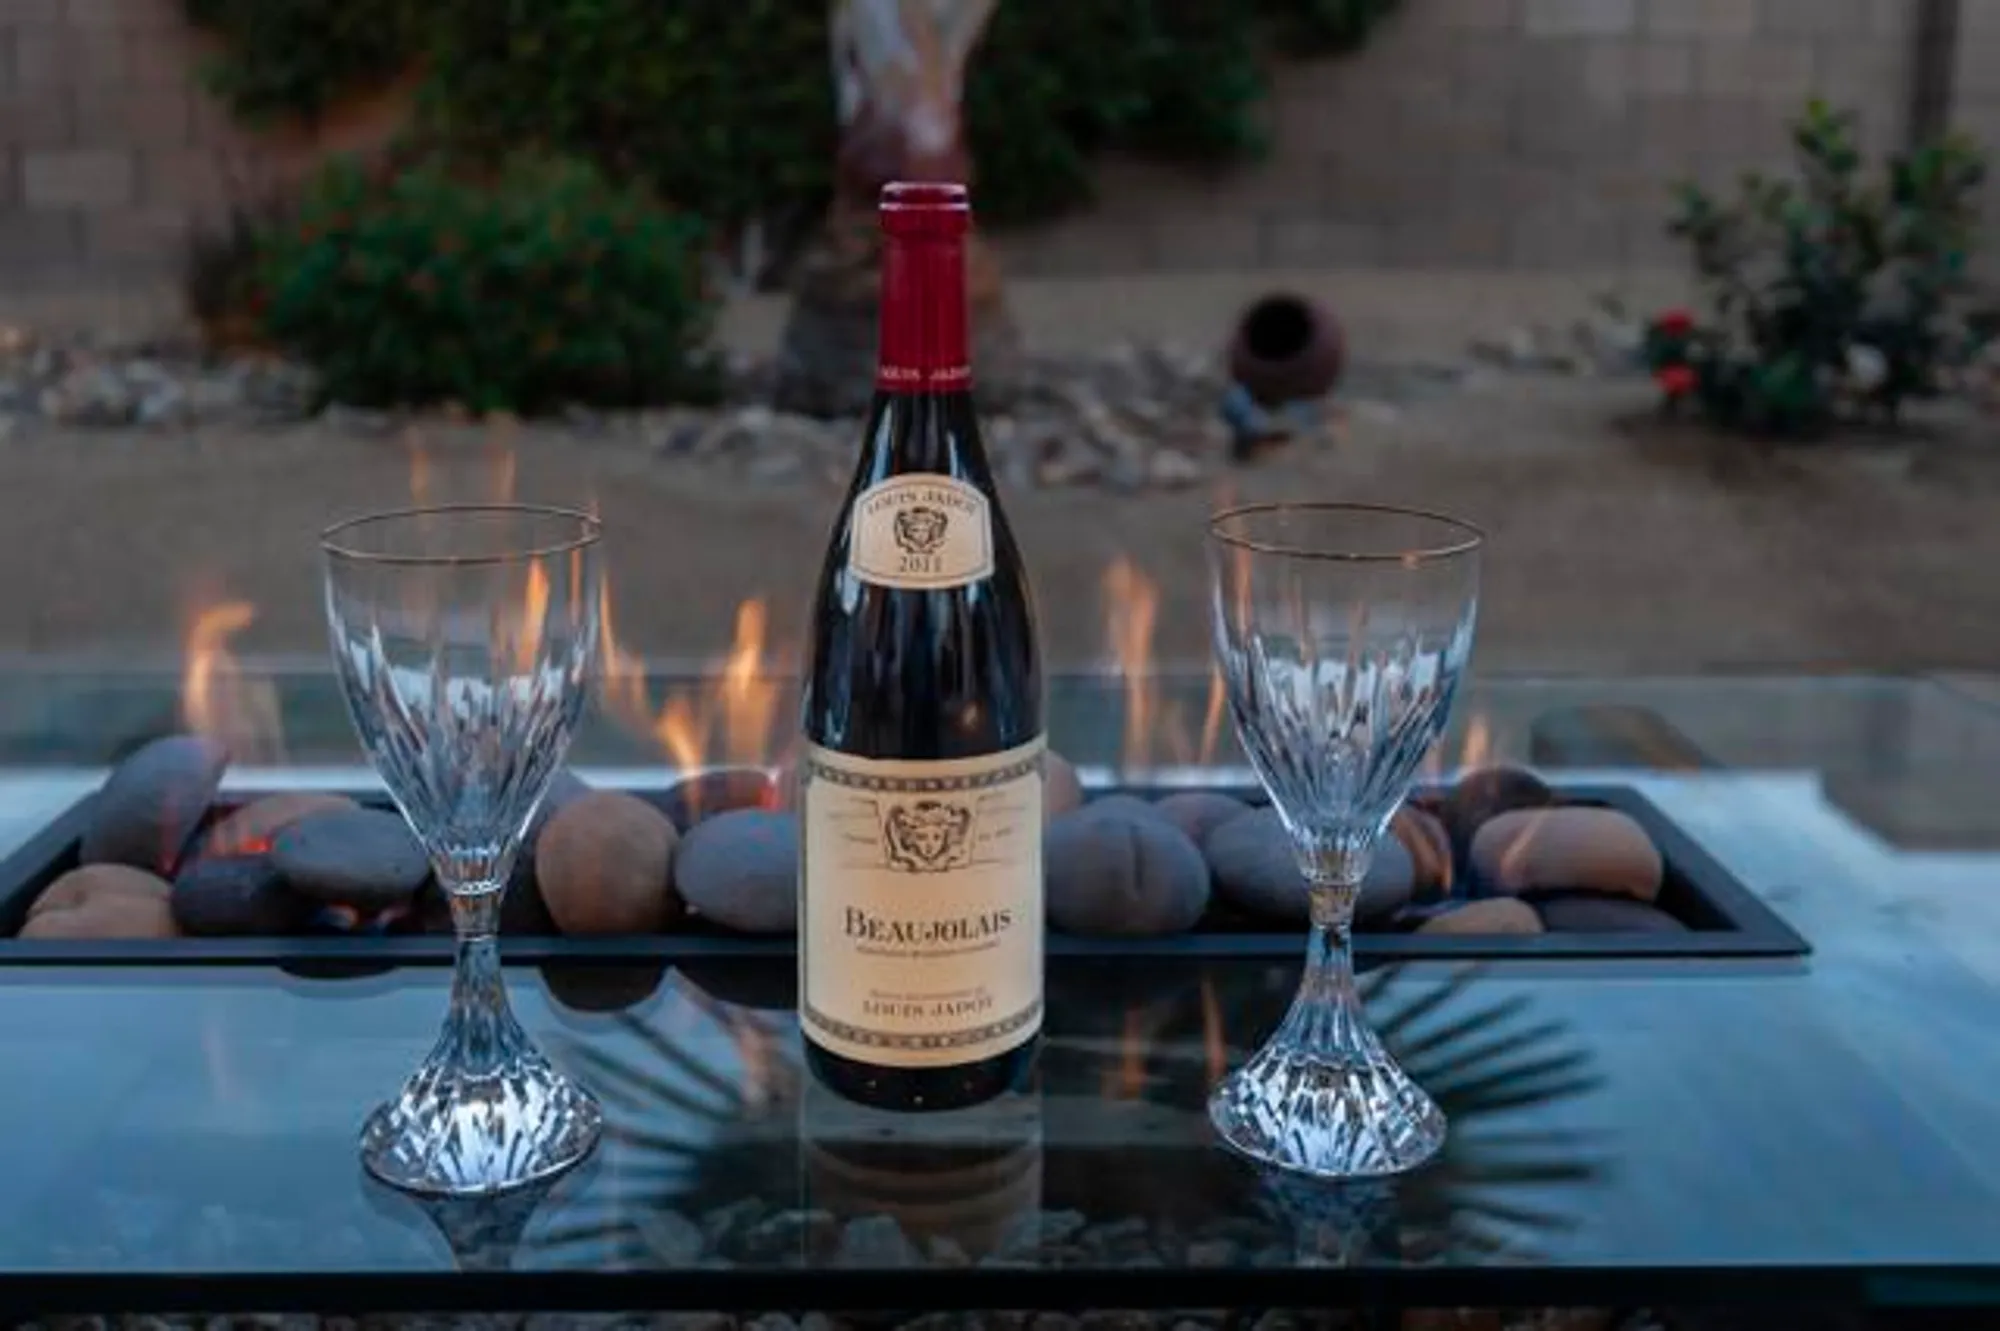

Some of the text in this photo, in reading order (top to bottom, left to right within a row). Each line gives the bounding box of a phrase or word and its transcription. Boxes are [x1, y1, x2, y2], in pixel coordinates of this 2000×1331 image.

[866, 491, 916, 515] LOUIS
[899, 556, 942, 572] 2011
[844, 906, 1012, 943] BEAUJOLAIS
[862, 995, 992, 1018] LOUIS JADOT
